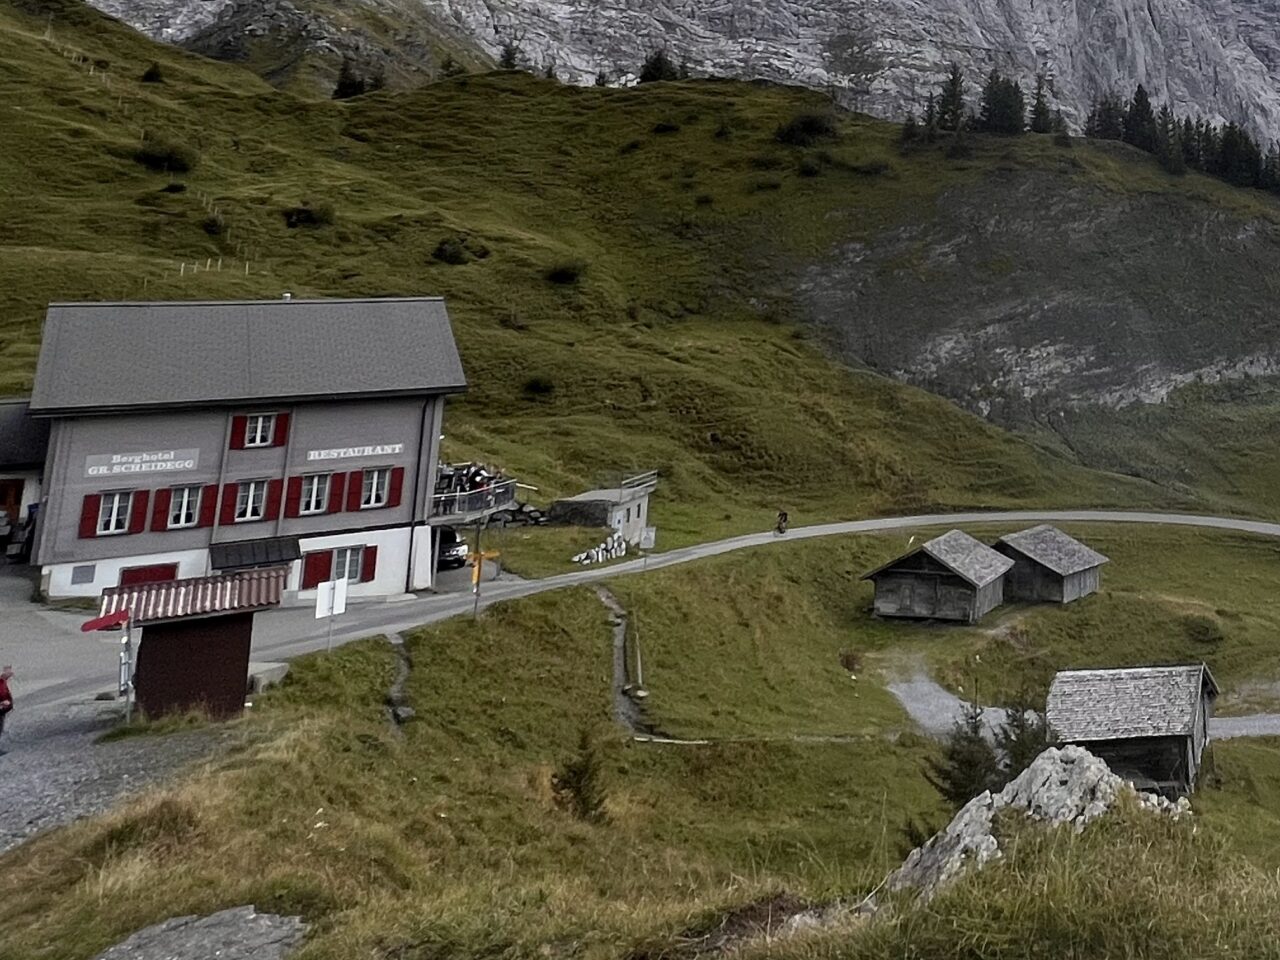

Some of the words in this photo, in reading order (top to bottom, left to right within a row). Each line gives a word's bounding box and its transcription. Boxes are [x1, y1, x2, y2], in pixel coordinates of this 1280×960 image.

[111, 451, 175, 464] Berghotel
[308, 444, 402, 460] RESTAURANT
[111, 460, 194, 473] SCHEIDEGG
